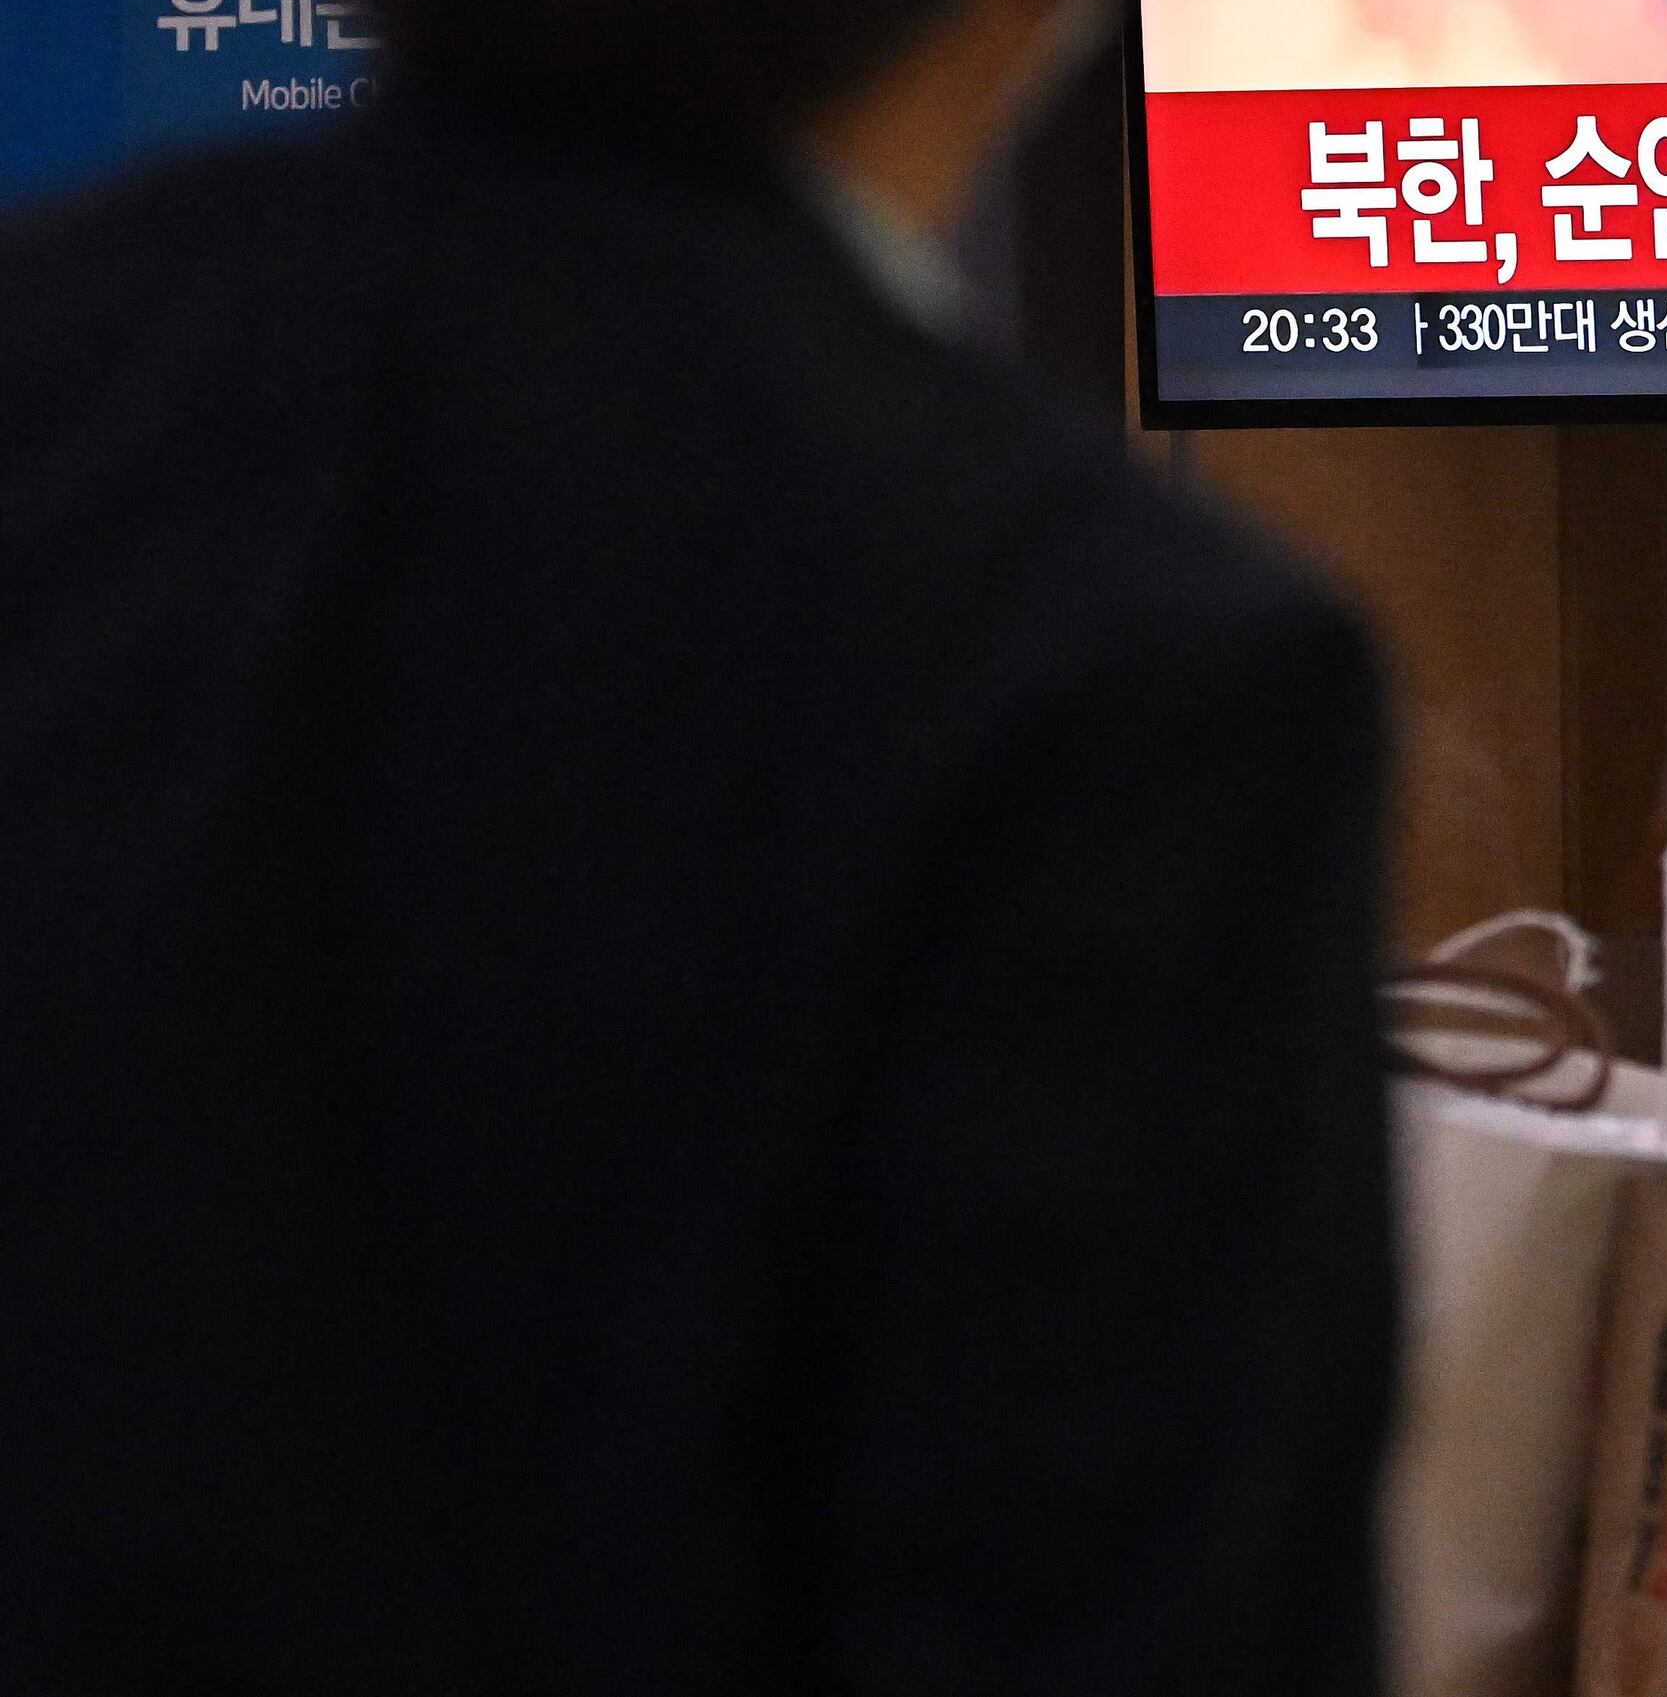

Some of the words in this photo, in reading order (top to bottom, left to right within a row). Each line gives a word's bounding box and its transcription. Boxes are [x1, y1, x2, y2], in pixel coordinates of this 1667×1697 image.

[241, 77, 342, 111] Mobile
[1301, 117, 1518, 284] 북한,
[1242, 307, 1378, 353] 20:33
[1439, 299, 1596, 353] 330만대
